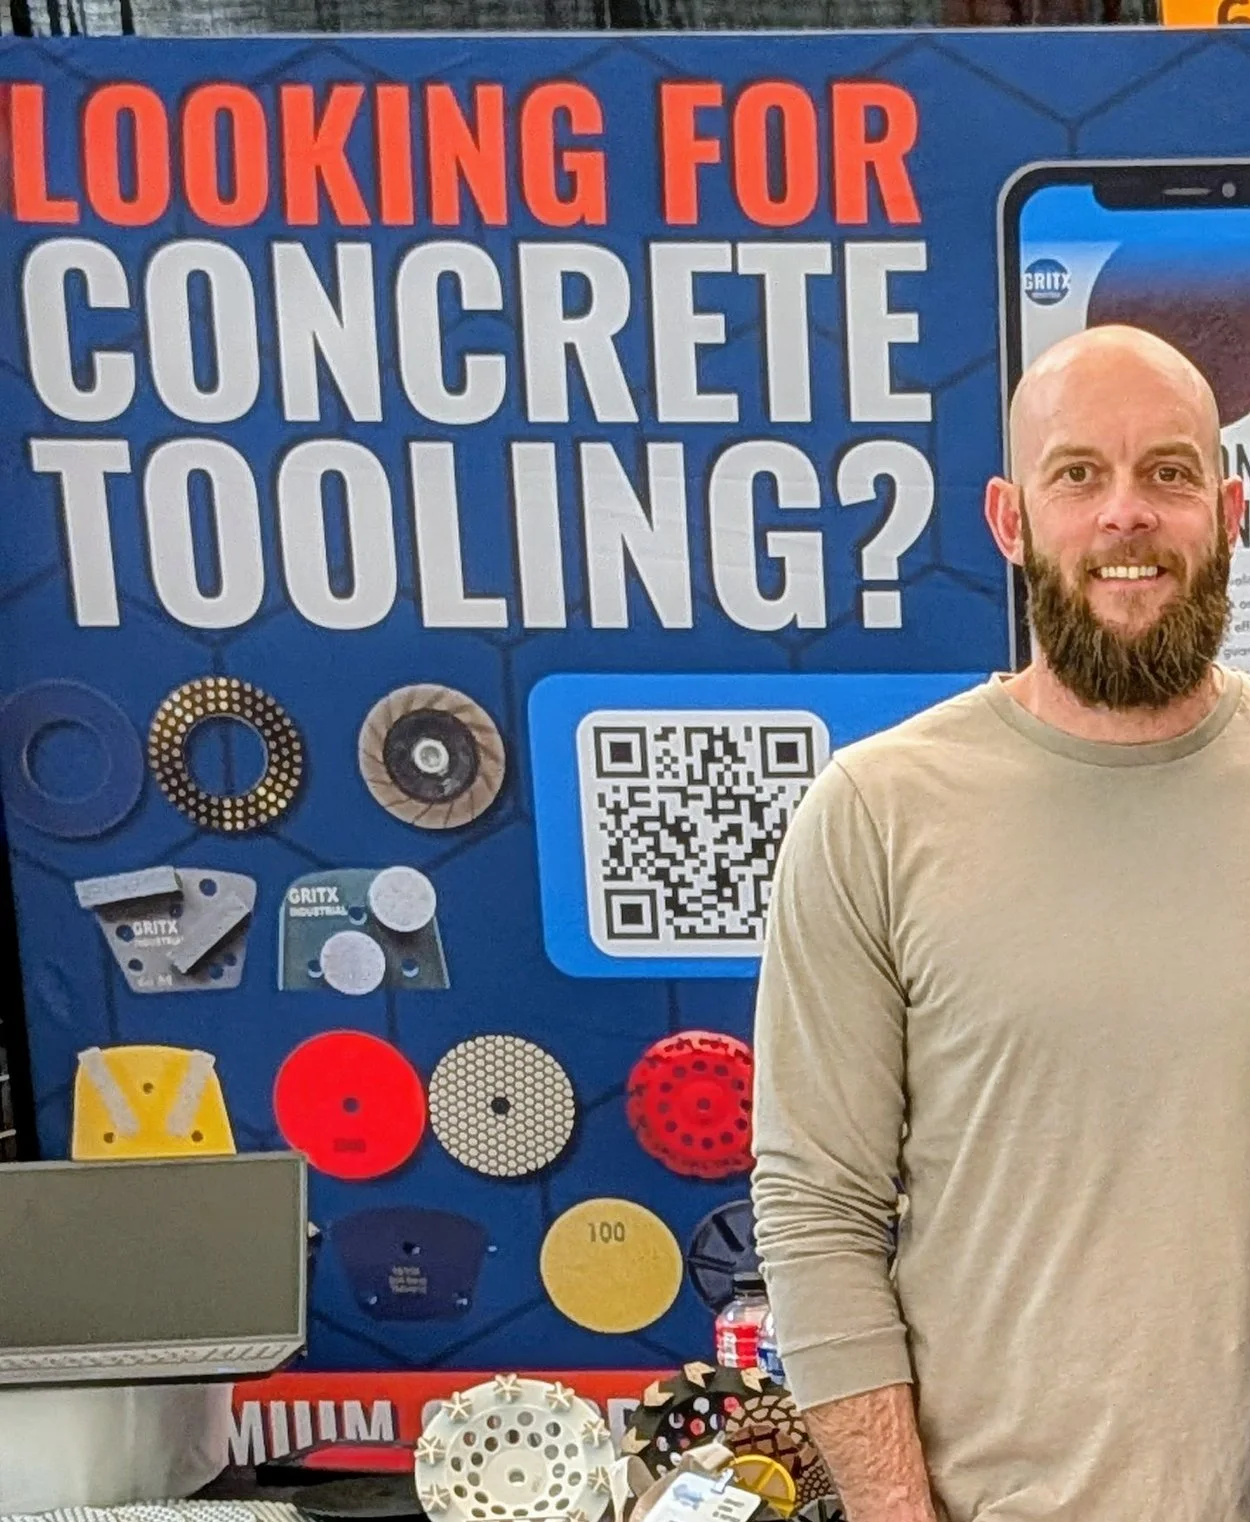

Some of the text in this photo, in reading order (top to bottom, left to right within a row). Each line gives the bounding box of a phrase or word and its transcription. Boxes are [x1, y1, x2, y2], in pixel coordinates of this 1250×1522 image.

[2, 80, 923, 228] LOOKING FOR
[1023, 271, 1071, 291] GRITX
[21, 237, 933, 425] CONCRETE
[29, 438, 936, 630] TOOLING?
[288, 886, 340, 905] GRITX
[132, 919, 179, 937] GRITX
[588, 1220, 626, 1243] 100
